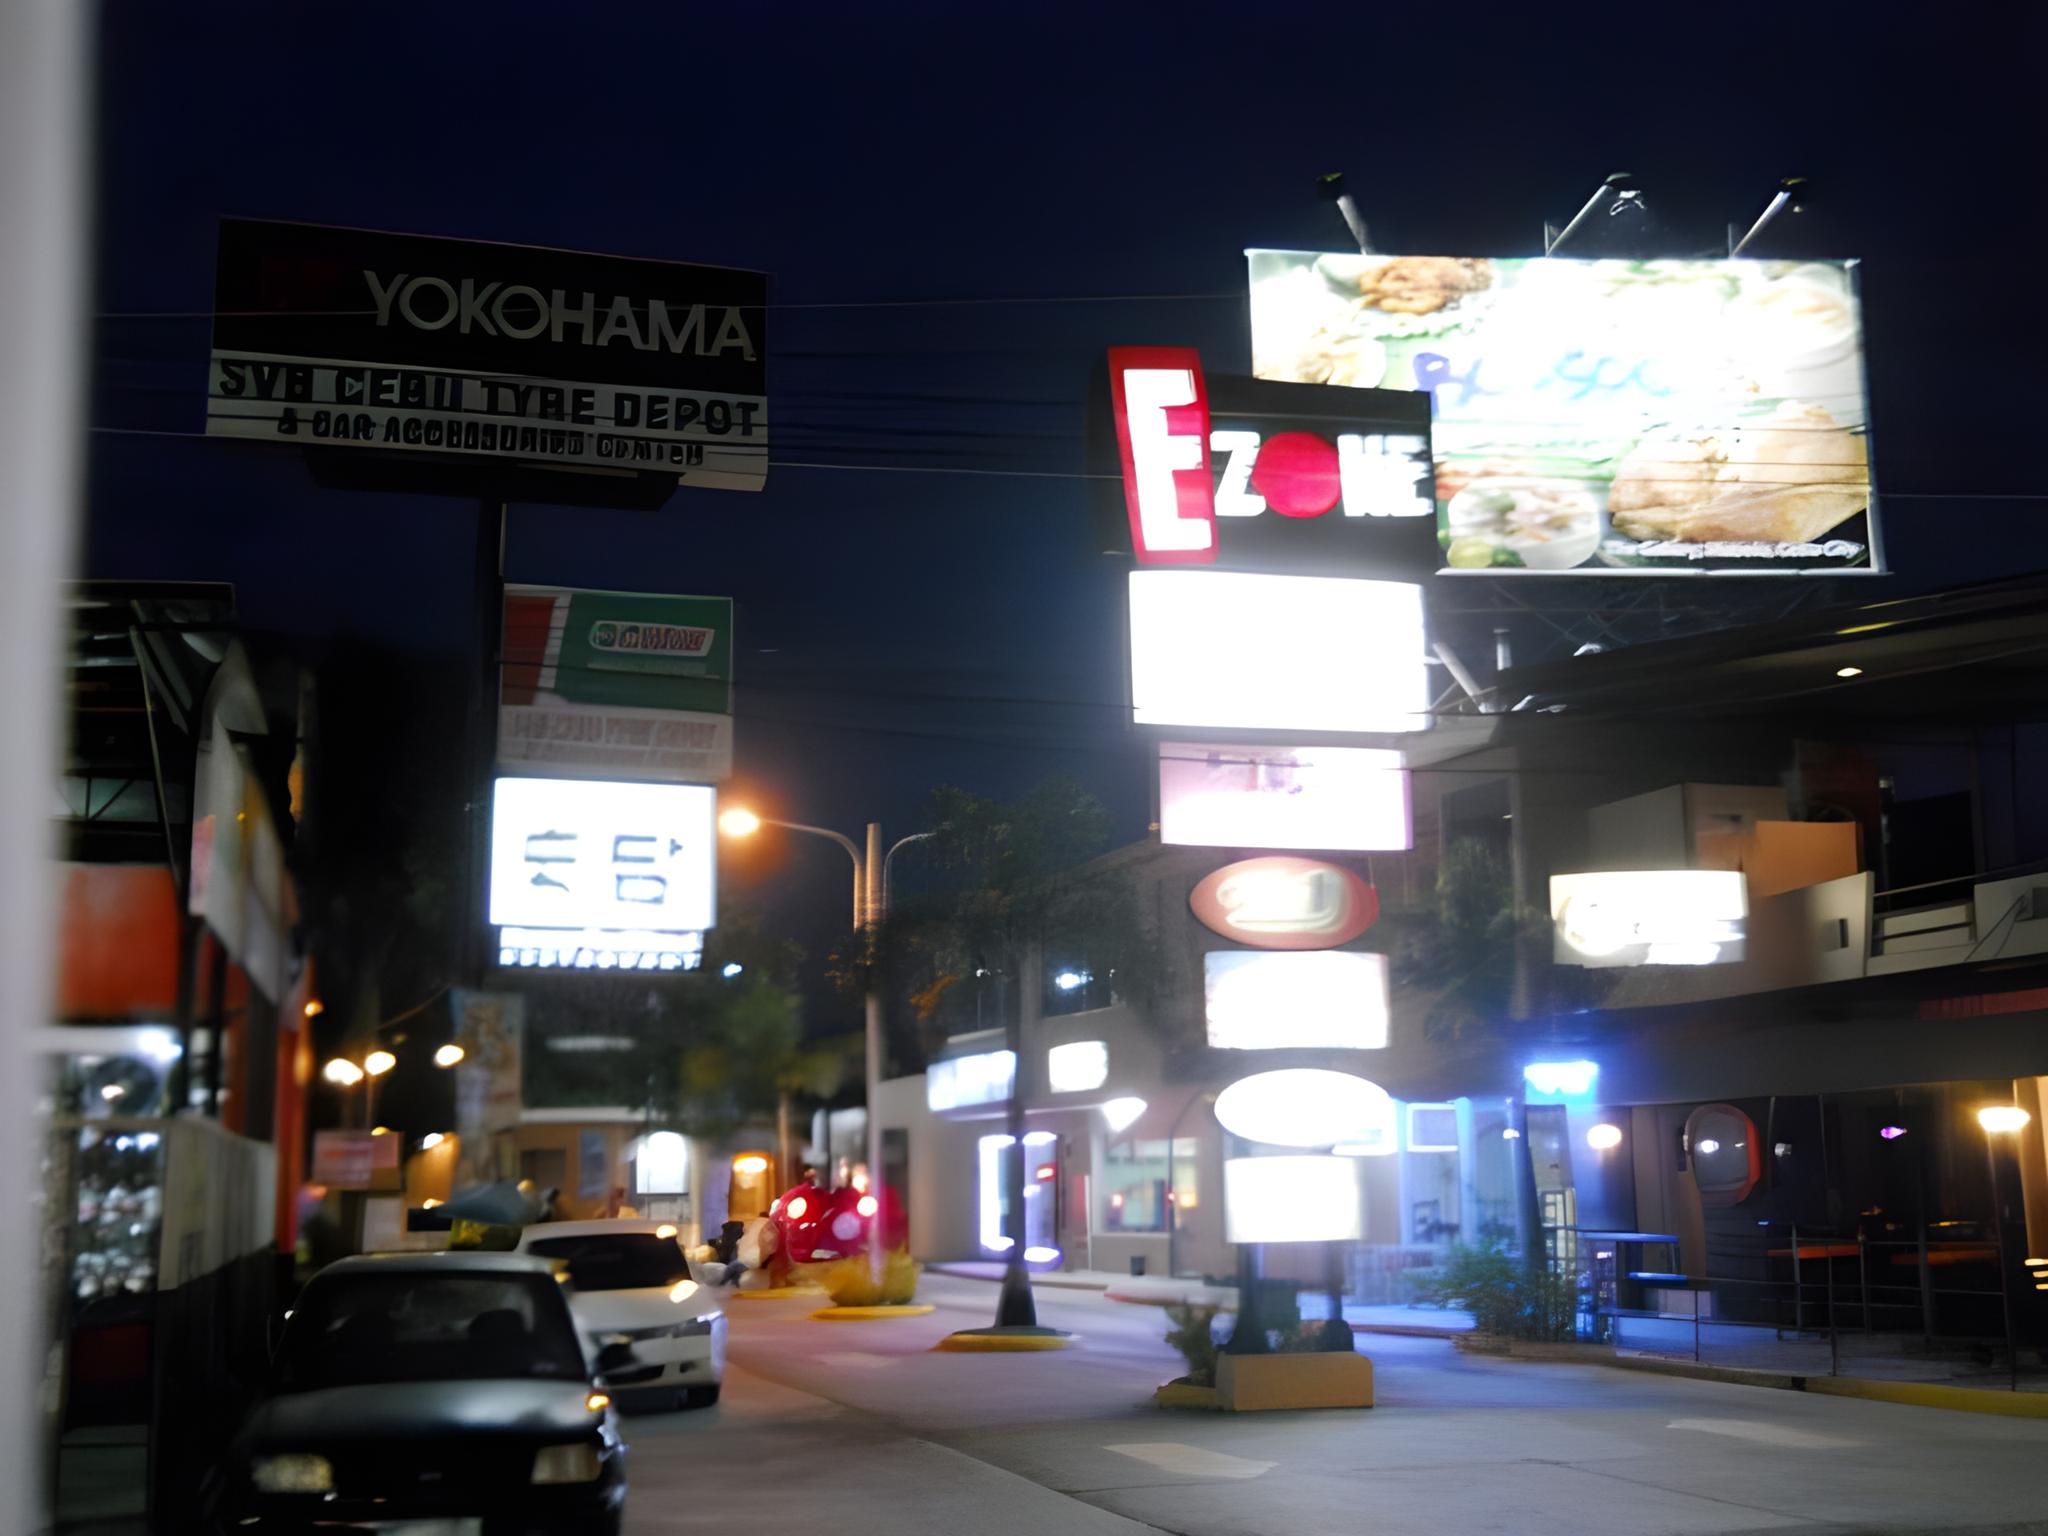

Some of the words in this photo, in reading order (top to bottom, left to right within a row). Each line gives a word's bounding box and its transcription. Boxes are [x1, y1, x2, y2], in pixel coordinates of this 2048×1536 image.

[363, 269, 757, 361] YOKOHAMA
[481, 375, 595, 425] TYRE
[614, 391, 760, 436] DEPOT
